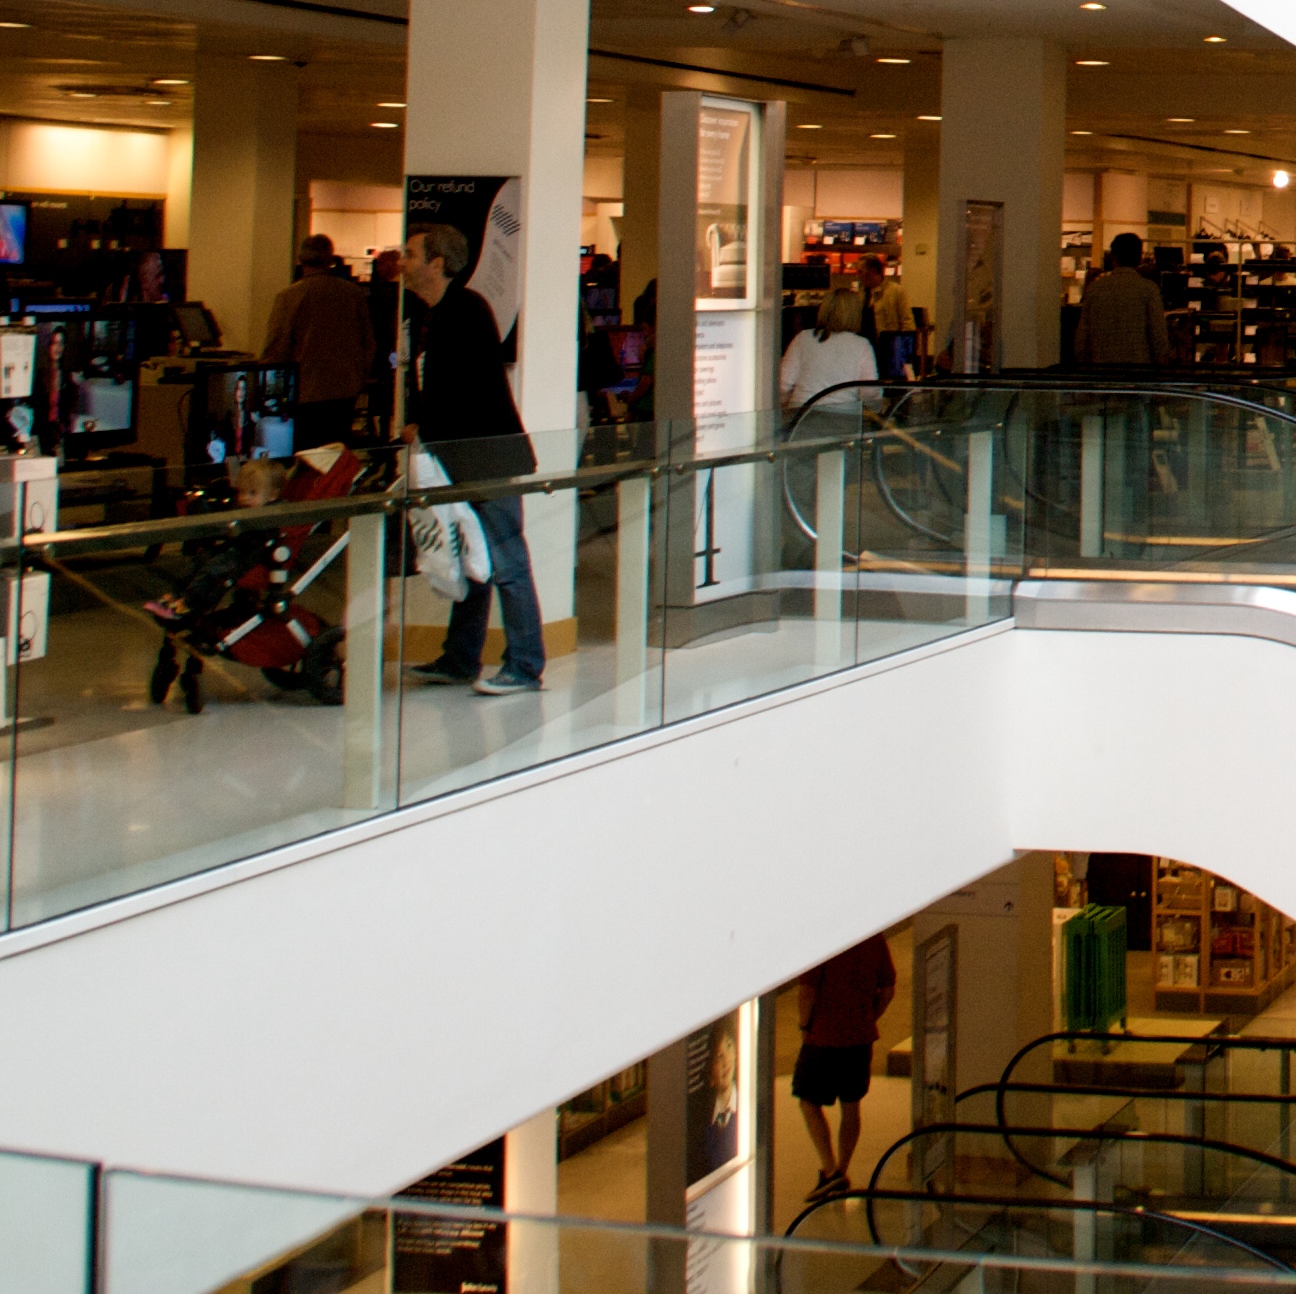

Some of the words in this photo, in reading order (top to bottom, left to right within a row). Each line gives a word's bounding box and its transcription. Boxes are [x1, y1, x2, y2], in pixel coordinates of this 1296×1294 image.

[410, 179, 435, 193] Our
[438, 179, 475, 193] refund
[408, 197, 441, 213] policy
